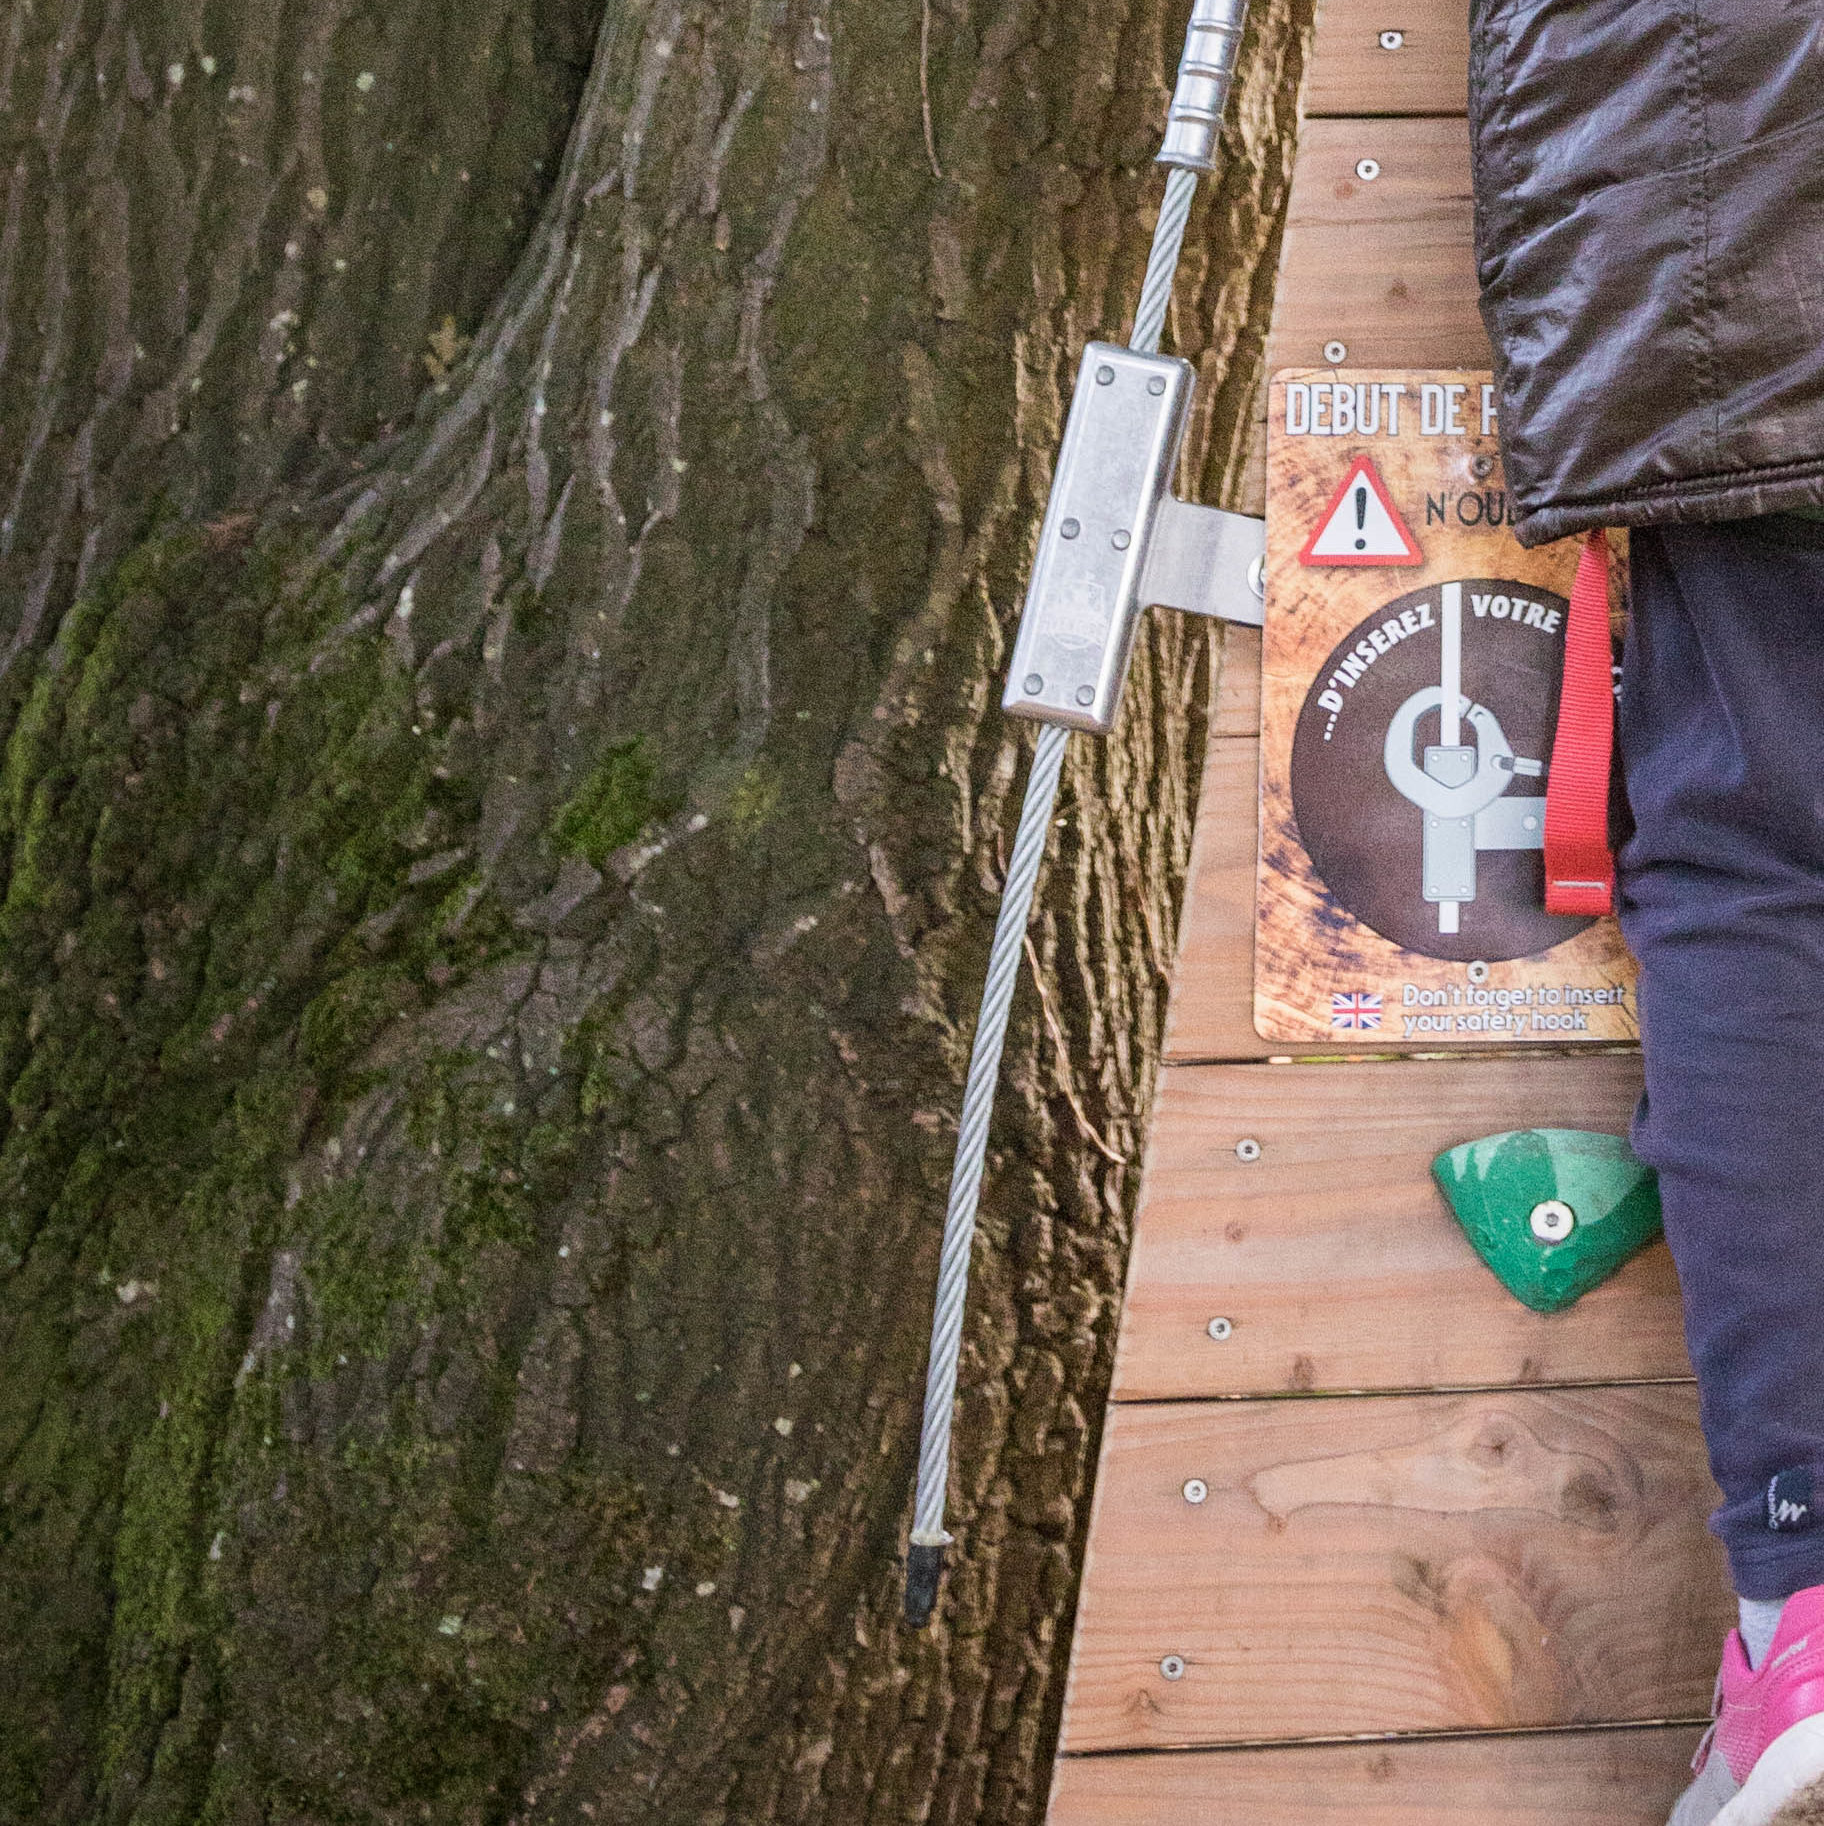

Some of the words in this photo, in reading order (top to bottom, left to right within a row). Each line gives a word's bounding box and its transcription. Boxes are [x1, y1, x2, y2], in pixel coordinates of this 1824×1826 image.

[1285, 383, 1406, 436] DEBUT
[1420, 383, 1466, 436] DE
[1470, 594, 1562, 634] VOTRE
[1402, 983, 1461, 1006] Don't
[1466, 983, 1533, 1011] forget
[1537, 984, 1561, 1005] to
[1564, 982, 1624, 1006] insert
[1402, 1015, 1452, 1038] your
[1456, 1010, 1527, 1037] safety
[1530, 1008, 1588, 1031] hook
